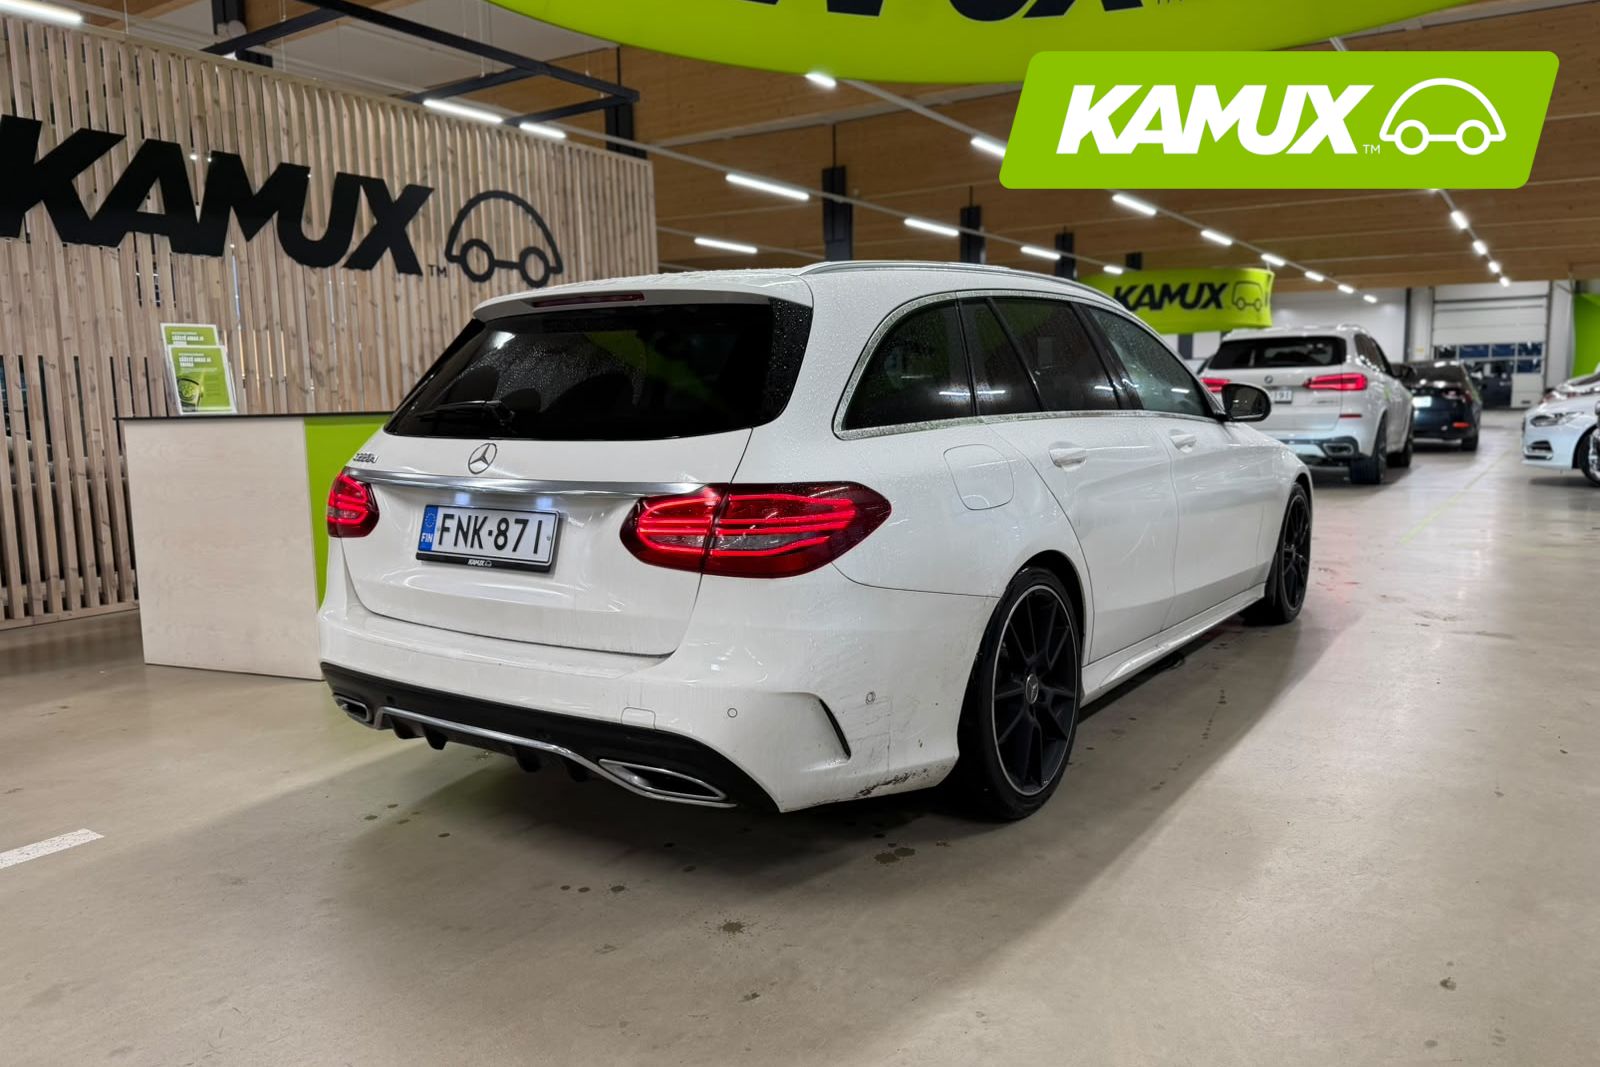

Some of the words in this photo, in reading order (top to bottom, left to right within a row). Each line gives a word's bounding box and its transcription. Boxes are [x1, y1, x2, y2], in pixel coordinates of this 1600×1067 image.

[0, 115, 434, 275] KAMUX
[1112, 281, 1227, 313] KAMUX
[421, 532, 434, 543] FIN
